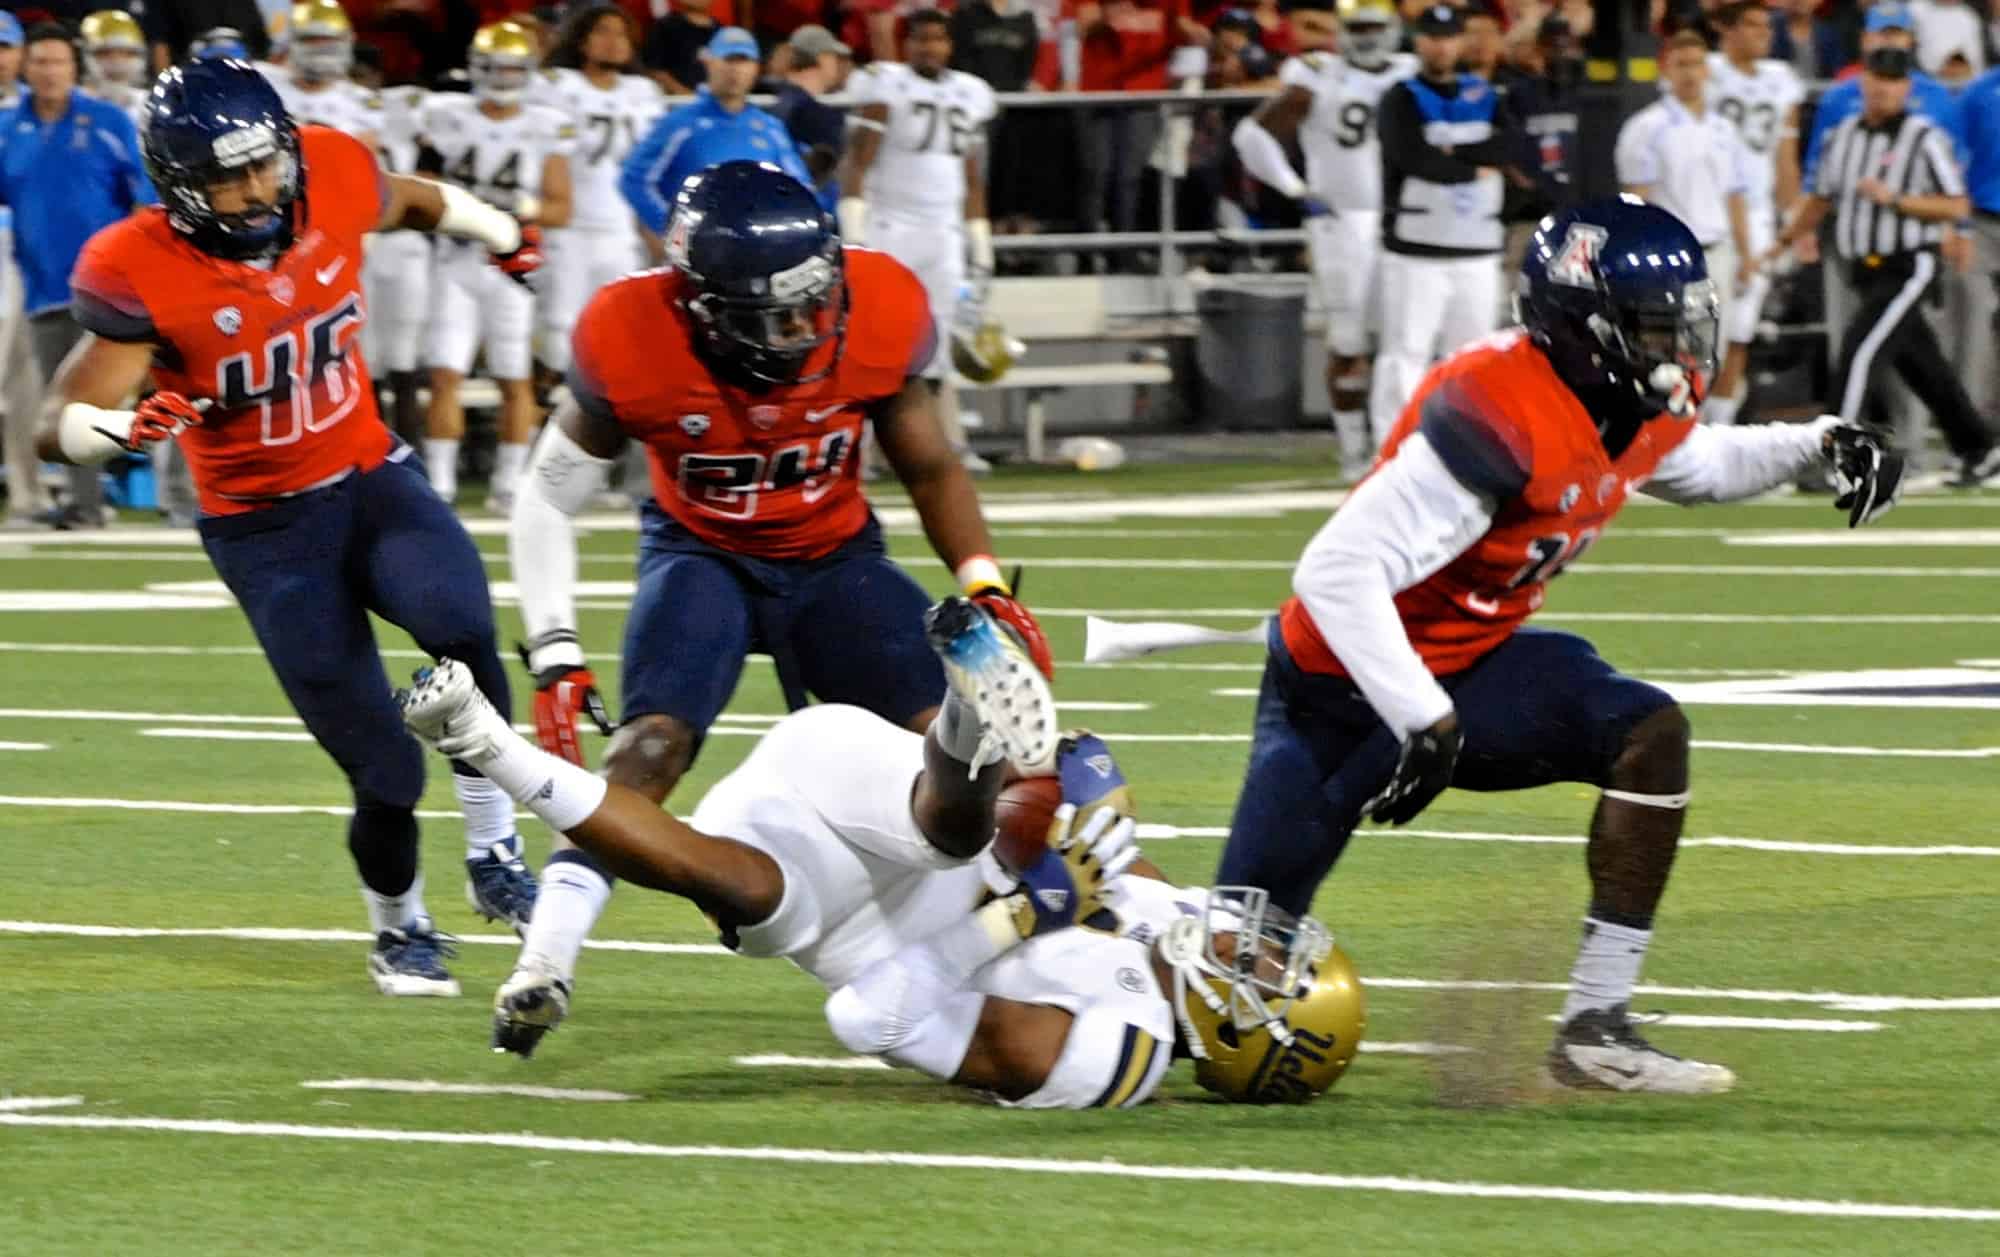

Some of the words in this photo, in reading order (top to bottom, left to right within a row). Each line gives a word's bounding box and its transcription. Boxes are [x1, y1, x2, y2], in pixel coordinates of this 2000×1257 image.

[448, 143, 522, 190] 44
[216, 289, 368, 447] 46
[678, 427, 856, 520] 24
